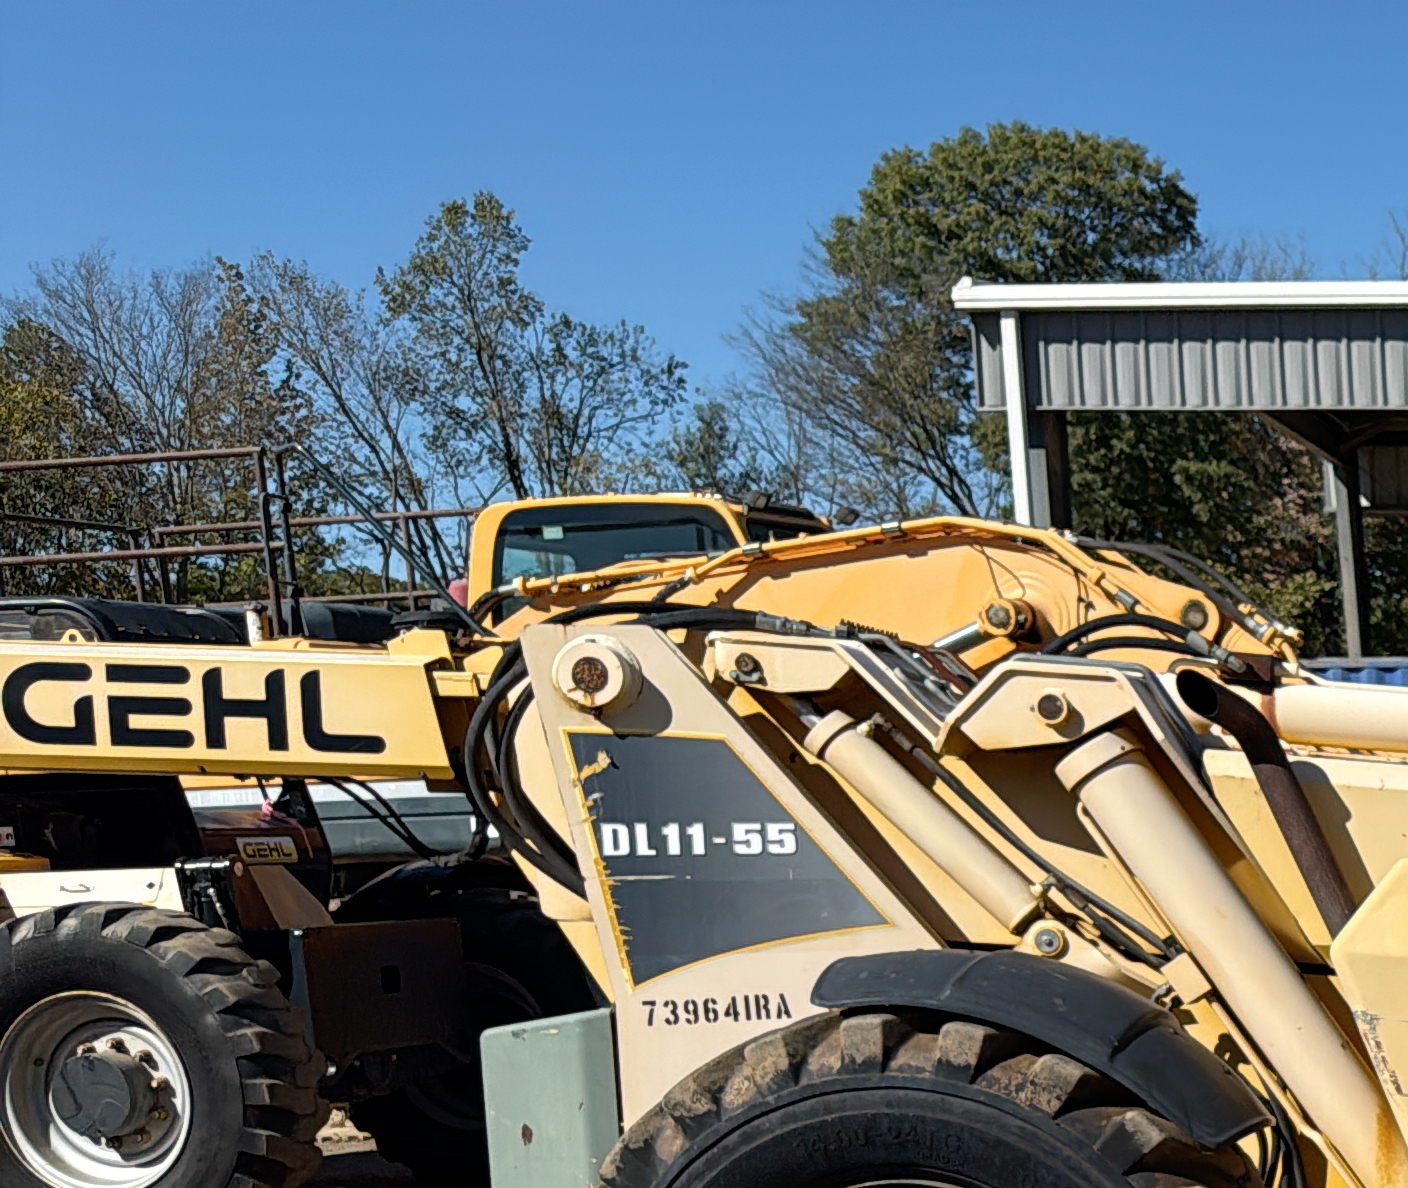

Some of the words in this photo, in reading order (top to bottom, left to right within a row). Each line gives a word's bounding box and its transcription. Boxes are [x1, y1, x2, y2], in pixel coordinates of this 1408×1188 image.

[2, 662, 387, 754] GEHL
[243, 841, 294, 858] GEHL
[600, 822, 798, 858] DL11-55
